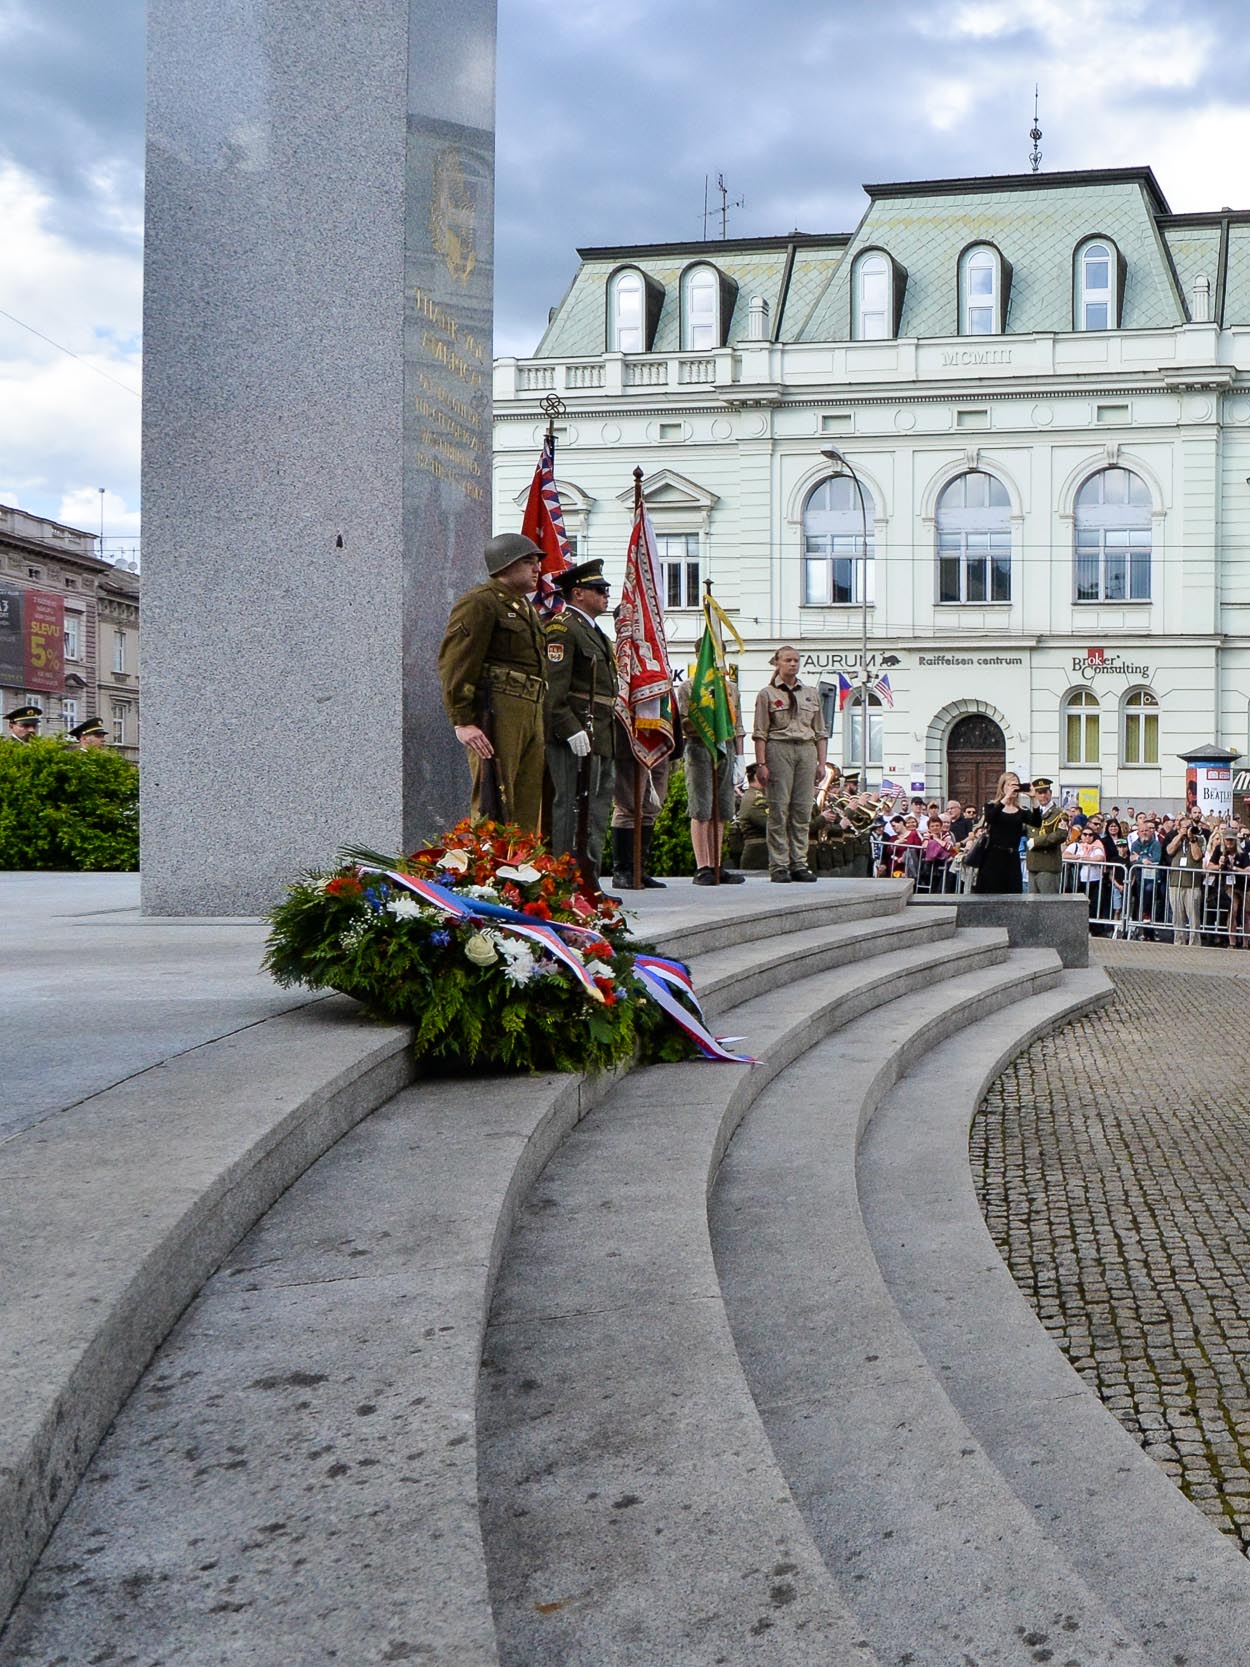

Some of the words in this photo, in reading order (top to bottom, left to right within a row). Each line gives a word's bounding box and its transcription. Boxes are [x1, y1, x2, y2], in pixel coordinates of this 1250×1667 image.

[31, 621, 60, 638] SLEVU
[918, 655, 974, 666] Raiffeisen
[977, 656, 1022, 666] centrum
[1072, 652, 1116, 672] Broker
[1082, 661, 1150, 681] Consulting
